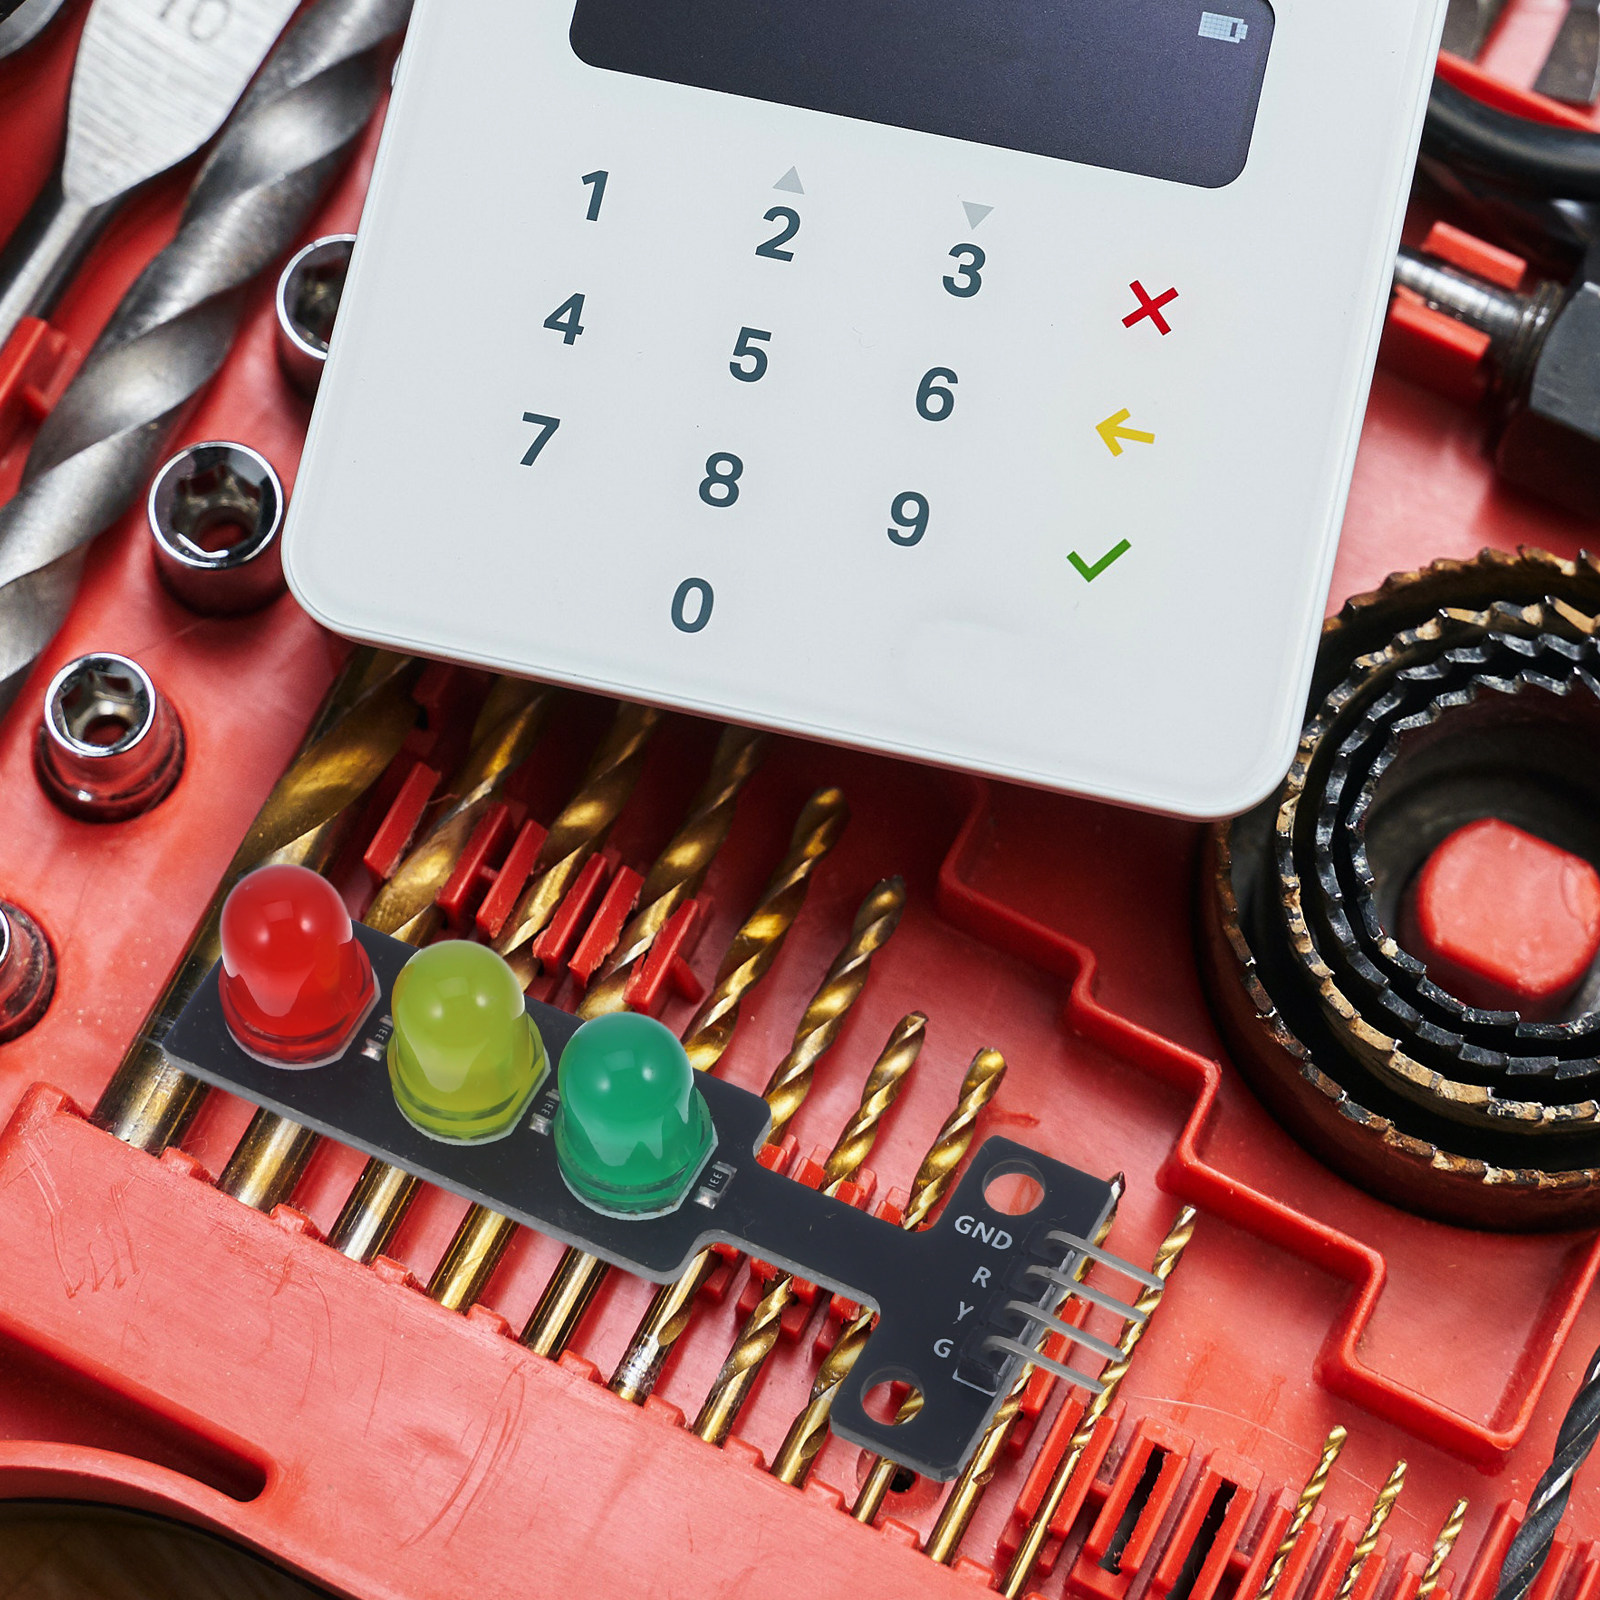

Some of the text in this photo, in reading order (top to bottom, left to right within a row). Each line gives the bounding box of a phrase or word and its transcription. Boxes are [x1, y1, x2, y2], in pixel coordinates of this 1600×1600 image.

[581, 169, 986, 299] 1 2 3
[543, 292, 959, 422] 4 5 6
[519, 411, 930, 547] 7 8 9
[670, 577, 715, 634] 0
[954, 1214, 1013, 1250] GND
[971, 1265, 992, 1289] R
[954, 1300, 975, 1324] Y
[933, 1338, 954, 1358] G
